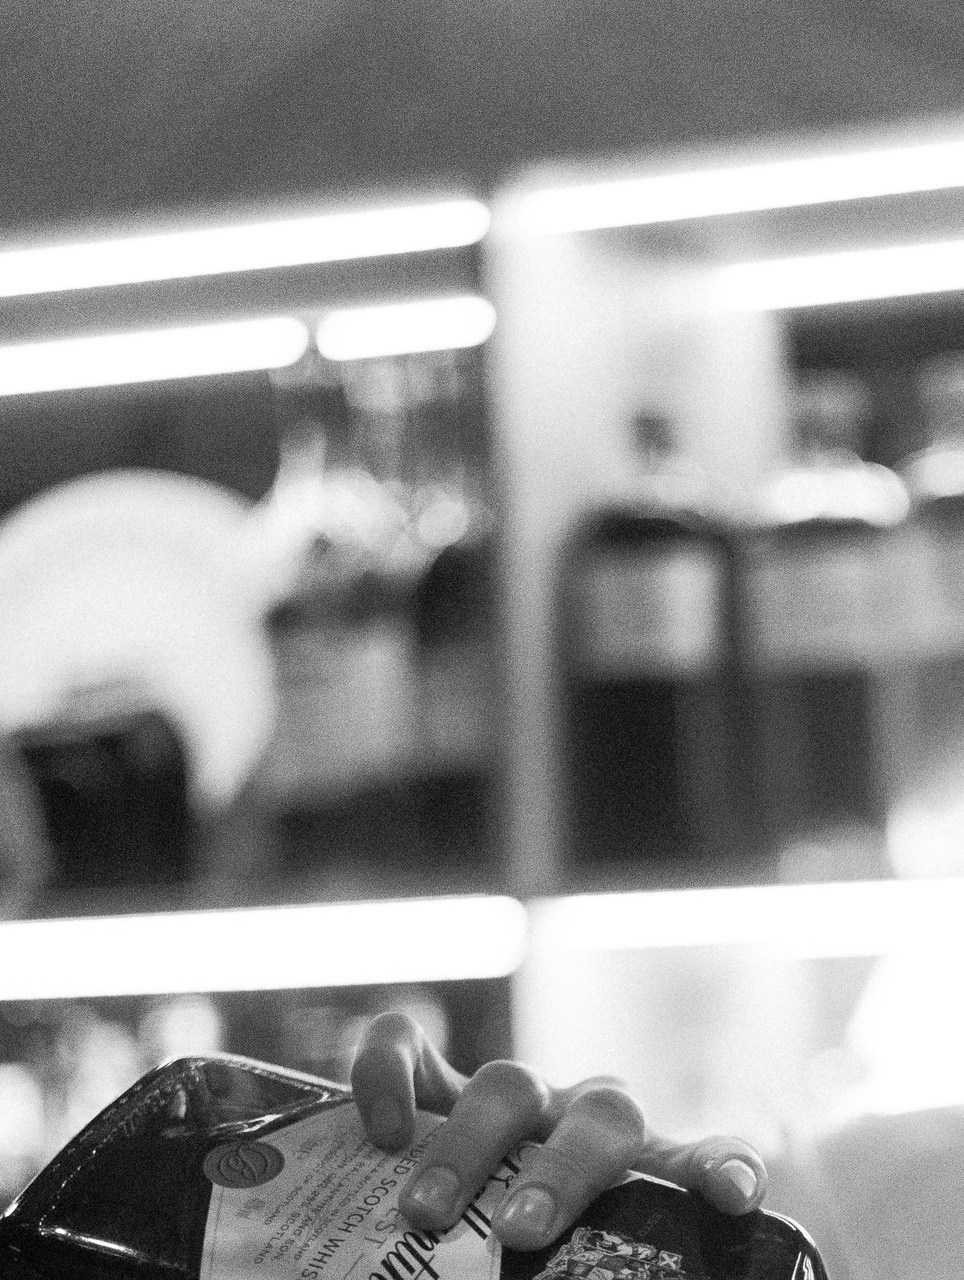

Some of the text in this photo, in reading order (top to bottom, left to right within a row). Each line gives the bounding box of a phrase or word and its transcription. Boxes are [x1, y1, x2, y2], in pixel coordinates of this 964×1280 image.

[263, 1186, 303, 1225] SCOTLAND
[311, 1161, 367, 1214] BALLANTINE
[335, 1177, 397, 1233] SCOTCH
[251, 1211, 301, 1264] SCOTLAND
[290, 1215, 314, 1236] AND
[291, 1218, 332, 1259] SCOTLAND
[359, 1208, 406, 1248] EST
